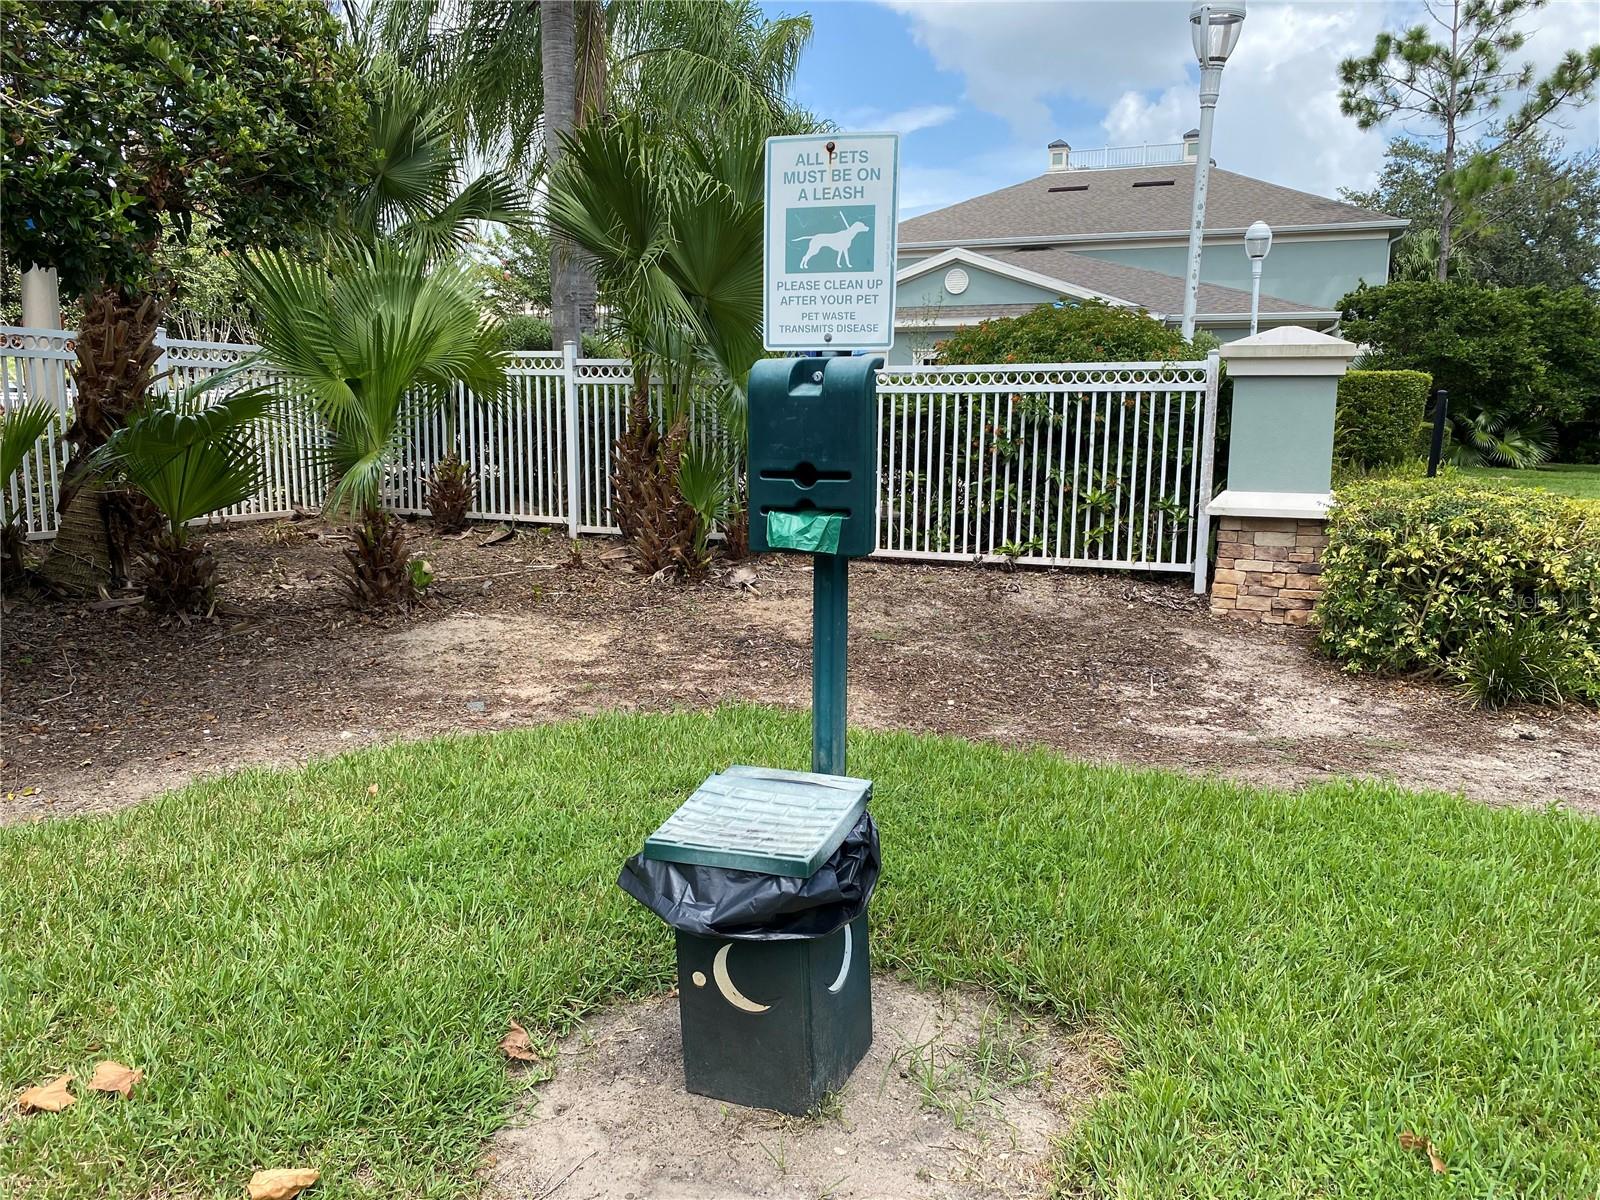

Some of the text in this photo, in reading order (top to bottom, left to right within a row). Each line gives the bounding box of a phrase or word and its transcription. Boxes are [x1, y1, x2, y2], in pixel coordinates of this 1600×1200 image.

[795, 150, 869, 166] ALL PETS
[783, 167, 881, 185] MUST BE ON
[797, 186, 865, 201] A LEASH
[776, 279, 883, 291] PLEASE CLEAN UP
[780, 294, 879, 306] AFTER YOUR PET
[801, 311, 856, 321] PET WASTE
[779, 323, 879, 333] TRANSMITS DISEASE
